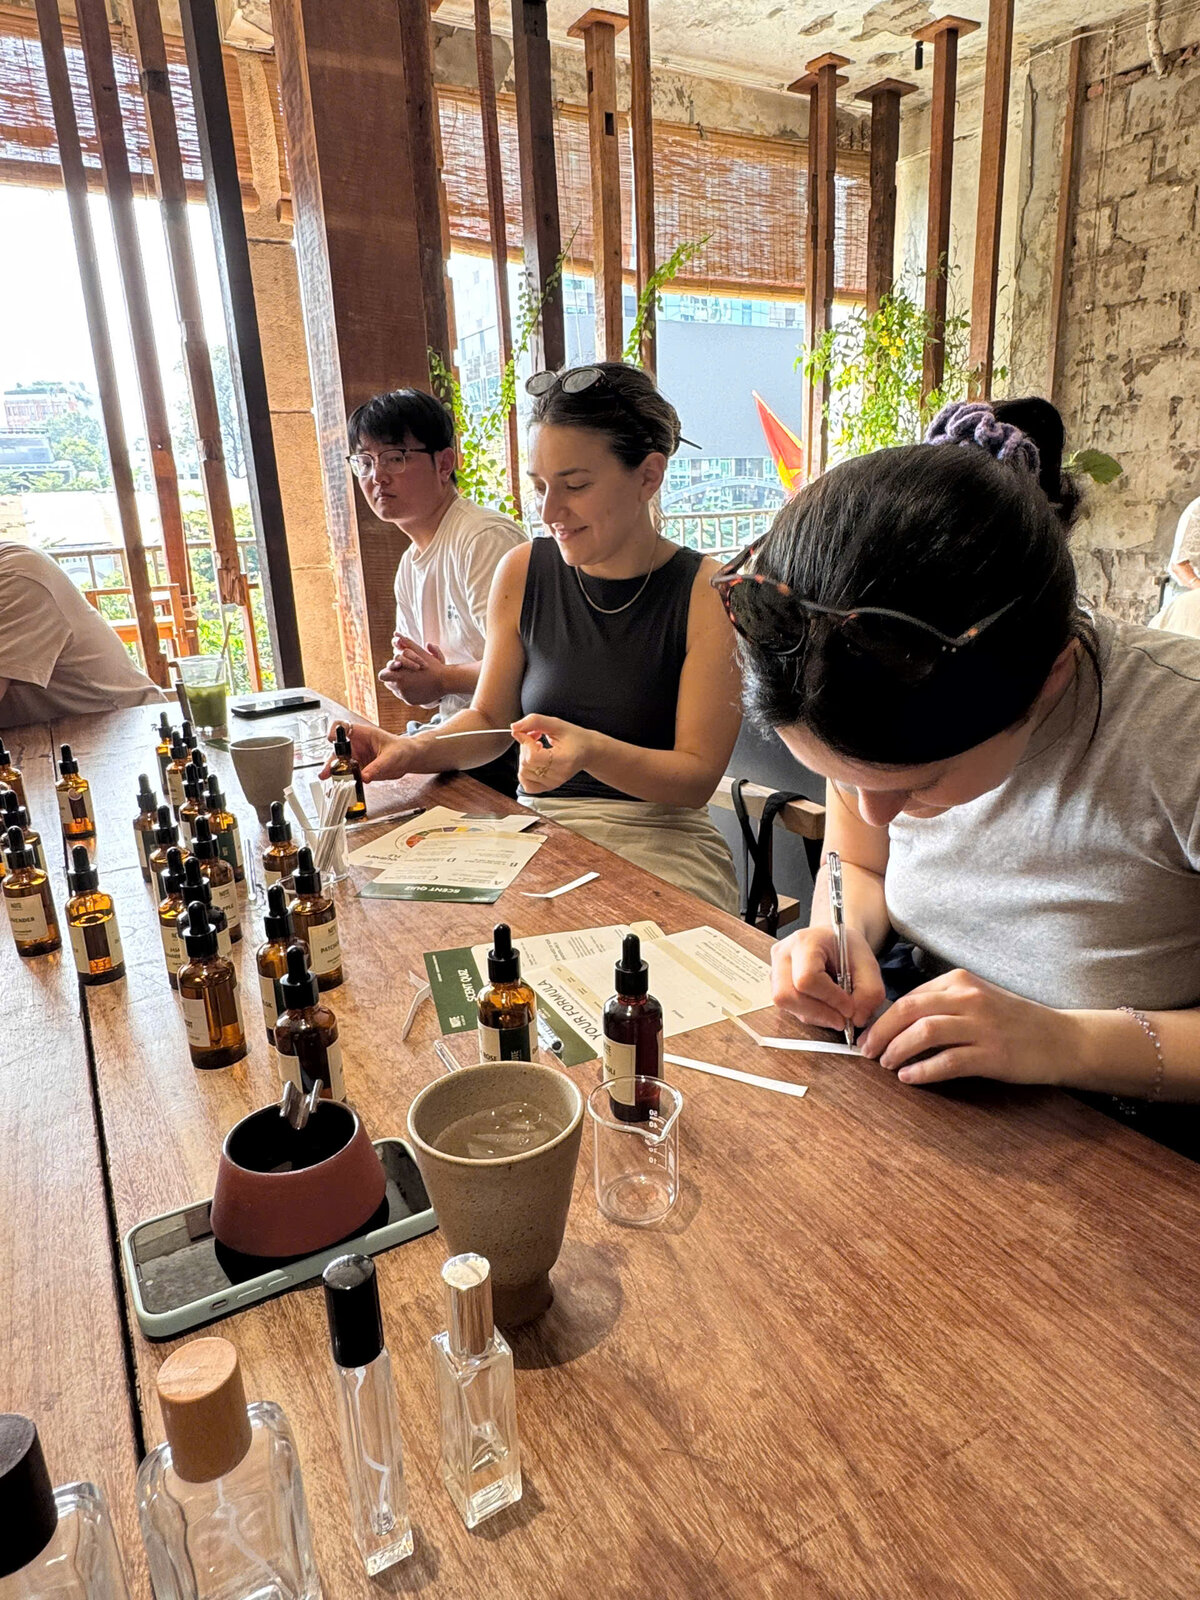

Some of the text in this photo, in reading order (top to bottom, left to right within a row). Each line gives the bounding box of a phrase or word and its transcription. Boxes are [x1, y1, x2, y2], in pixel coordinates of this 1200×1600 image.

[428, 886, 461, 894] SCENT
[457, 968, 478, 1002] SCENT QUIZ
[537, 979, 580, 1017] FORMULA
[573, 1015, 602, 1041] YOUR
